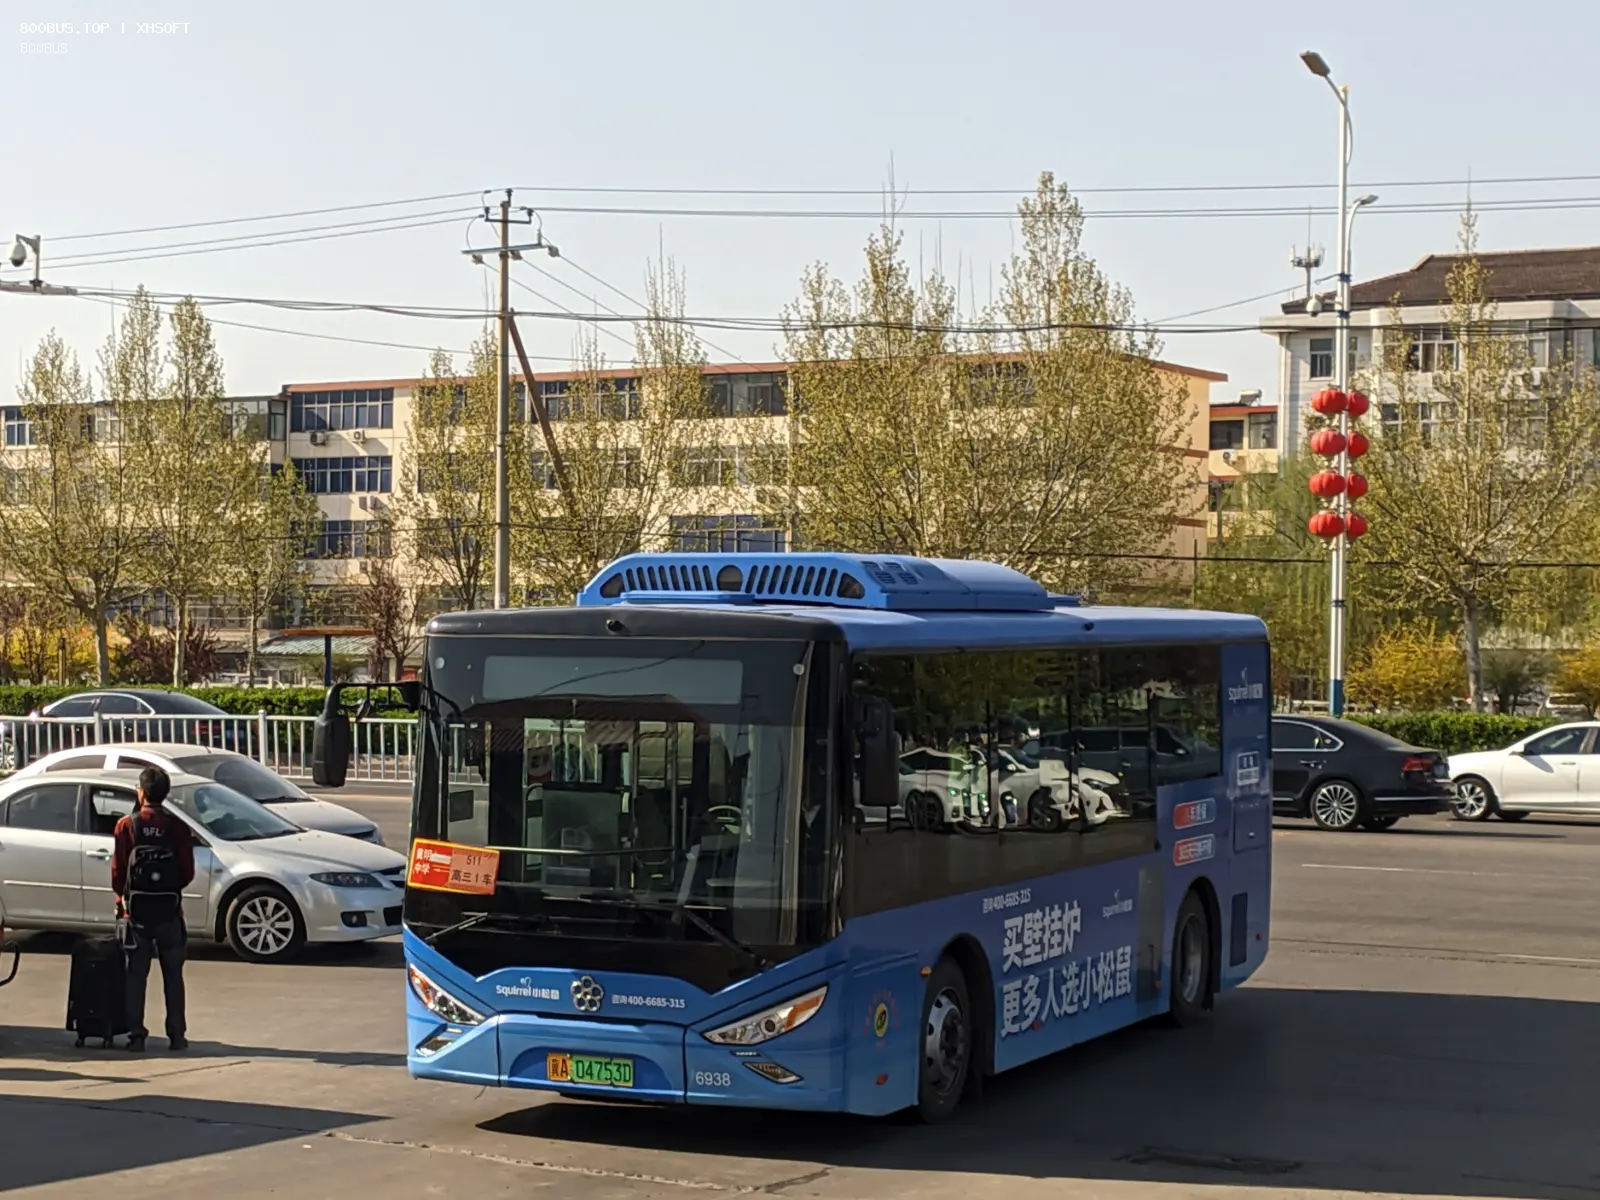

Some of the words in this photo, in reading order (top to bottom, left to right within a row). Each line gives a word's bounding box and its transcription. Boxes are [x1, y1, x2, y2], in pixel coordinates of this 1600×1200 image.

[466, 854, 482, 866] 511
[1002, 900, 1081, 973] 买壁挂炉
[1001, 945, 1132, 1038] 更多人选小松鼠
[695, 1071, 731, 1086] 6938
